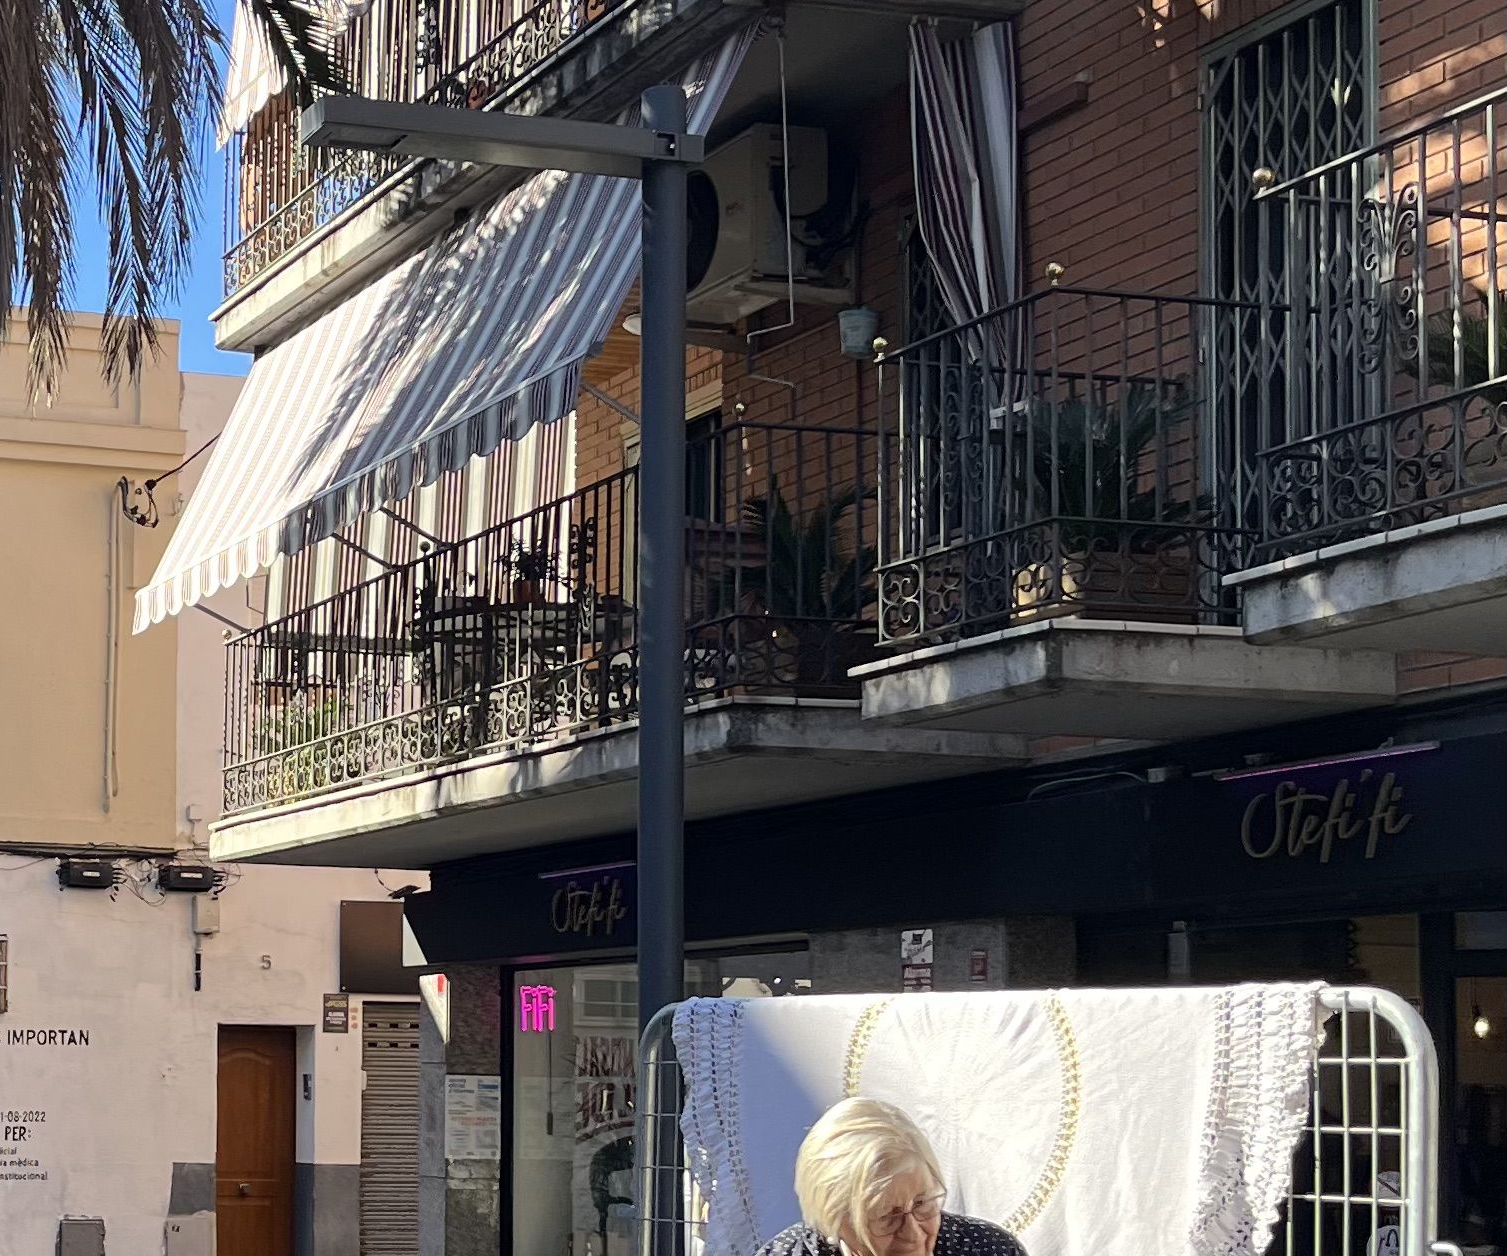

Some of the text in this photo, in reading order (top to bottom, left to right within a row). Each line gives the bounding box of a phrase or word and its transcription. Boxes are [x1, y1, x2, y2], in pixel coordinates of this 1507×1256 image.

[260, 954, 272, 970] 5
[7, 1029, 90, 1046] IMPORTAN
[4, 1126, 32, 1141] PER:
